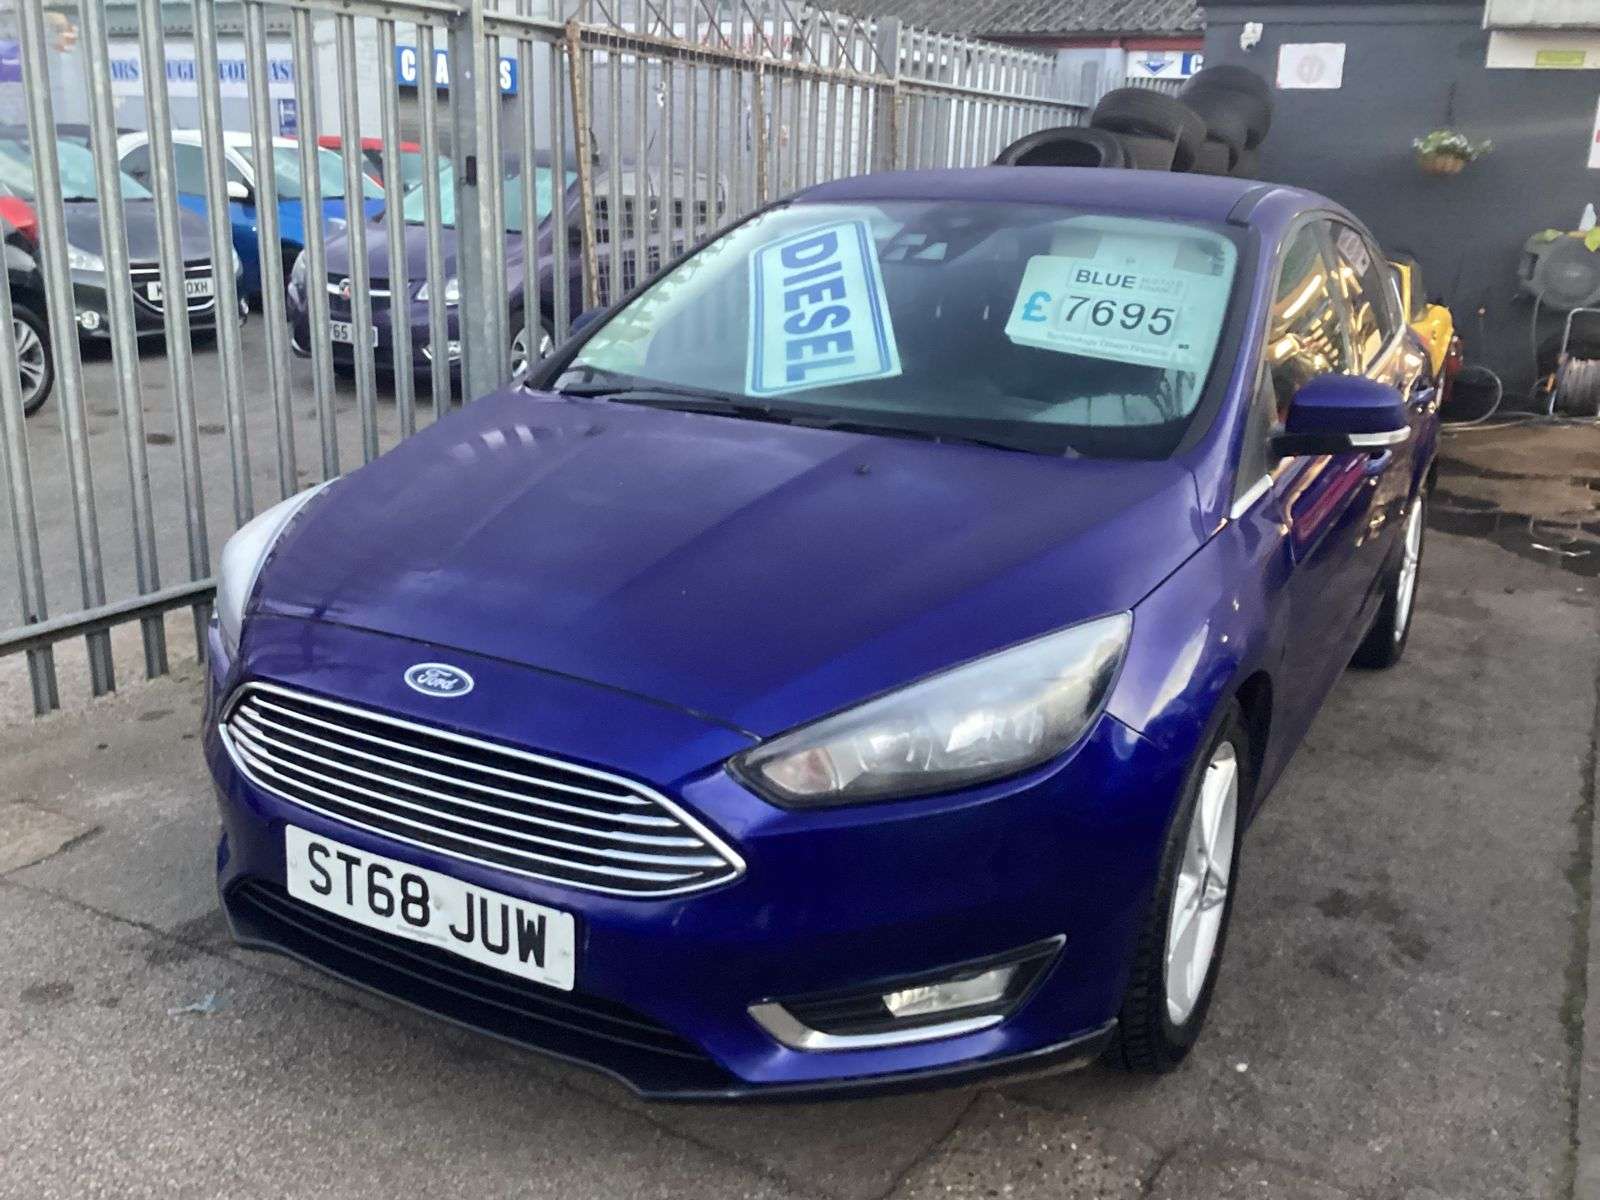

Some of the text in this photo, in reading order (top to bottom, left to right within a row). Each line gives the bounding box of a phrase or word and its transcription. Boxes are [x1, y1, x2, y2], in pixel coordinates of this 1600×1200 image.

[781, 231, 855, 382] DIESEL
[1075, 268, 1137, 289] BLUE
[417, 668, 460, 690] Ford
[307, 841, 547, 968] ST68 JUW
